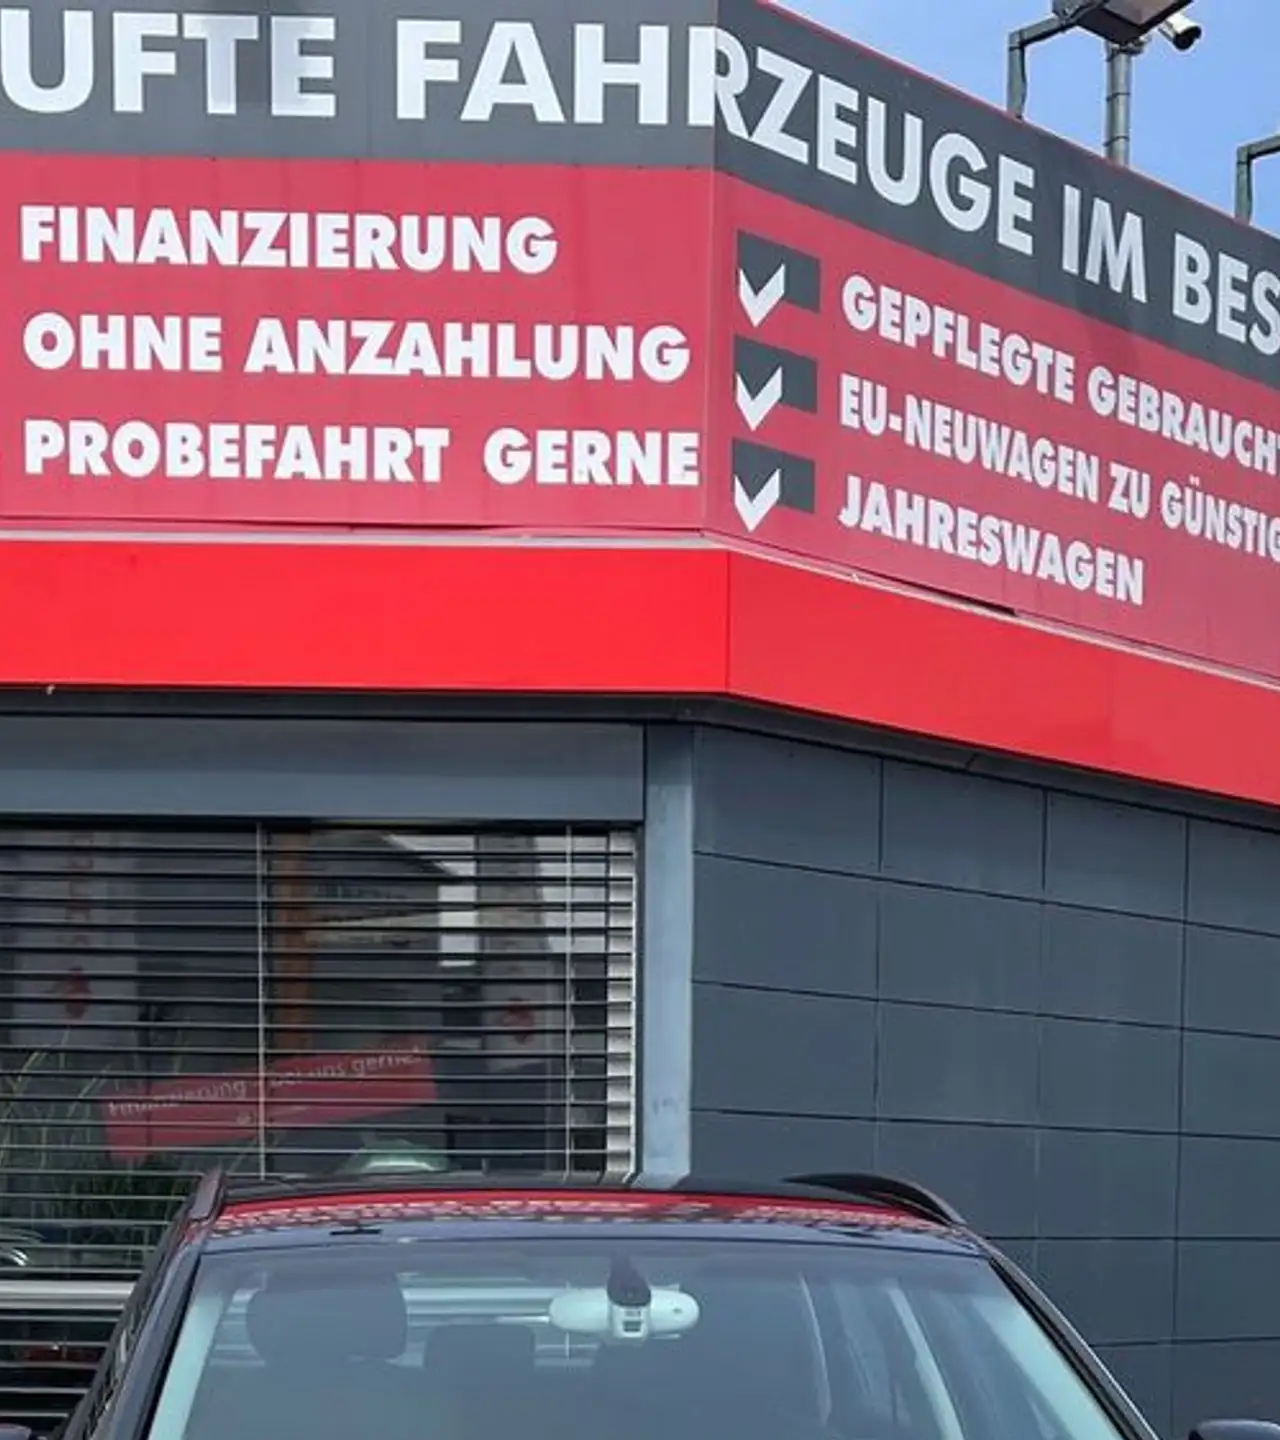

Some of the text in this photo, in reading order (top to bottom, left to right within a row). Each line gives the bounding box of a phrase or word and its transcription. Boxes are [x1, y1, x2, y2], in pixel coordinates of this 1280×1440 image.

[395, 19, 1035, 255] FAHRZEUGE
[1062, 186, 1147, 303] IM
[21, 206, 558, 274] FINANZIERUNG
[23, 312, 691, 382] OHNE ANZAHLUNG
[841, 276, 1074, 404] GEPFLEGTE
[24, 419, 700, 487] PROBEFAHRT GERNE
[841, 374, 1098, 502] EU-NEUWAGEN
[1110, 463, 1150, 518] ZU
[839, 476, 1143, 605] JAHRESWAGEN
